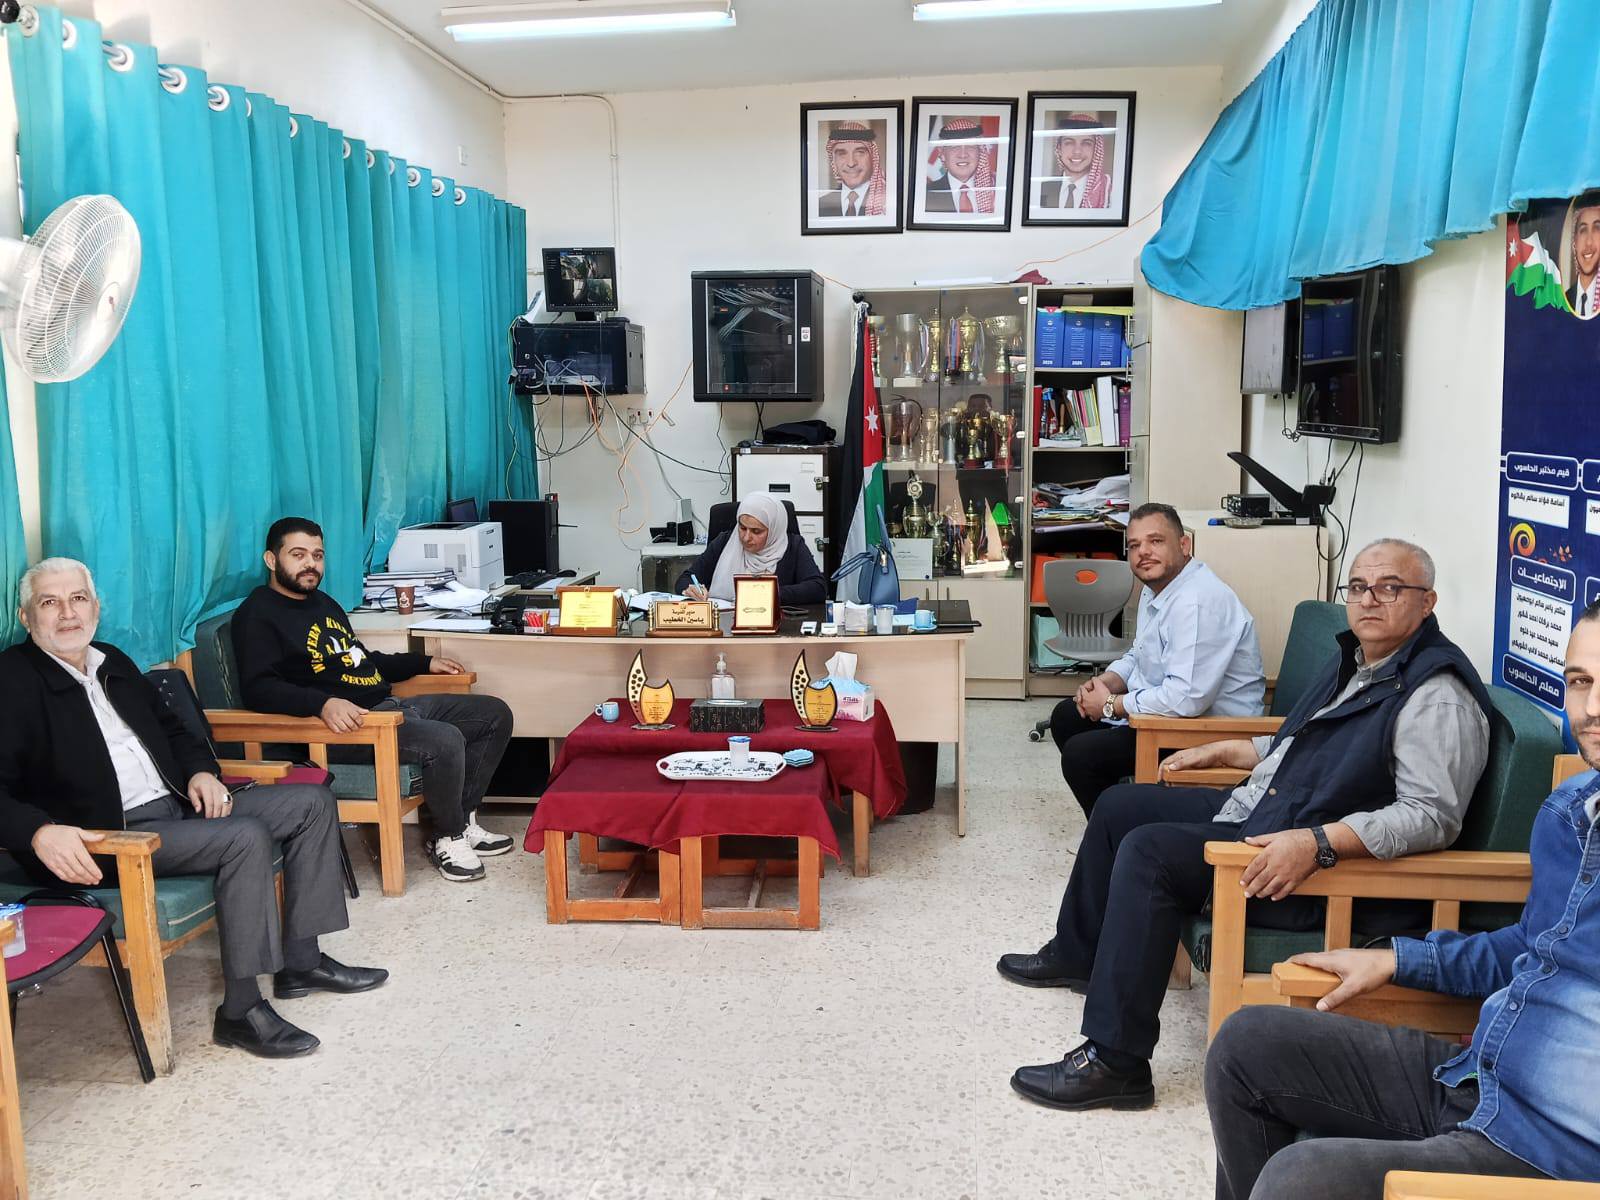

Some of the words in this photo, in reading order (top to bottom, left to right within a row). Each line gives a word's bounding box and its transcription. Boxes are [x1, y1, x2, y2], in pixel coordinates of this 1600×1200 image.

[1514, 464, 1538, 472] الحاسوب
[1538, 466, 1556, 475] مختبر
[1556, 468, 1570, 478] قيم
[1508, 667, 1537, 686] الحاسوب
[1539, 682, 1559, 697] معلم
